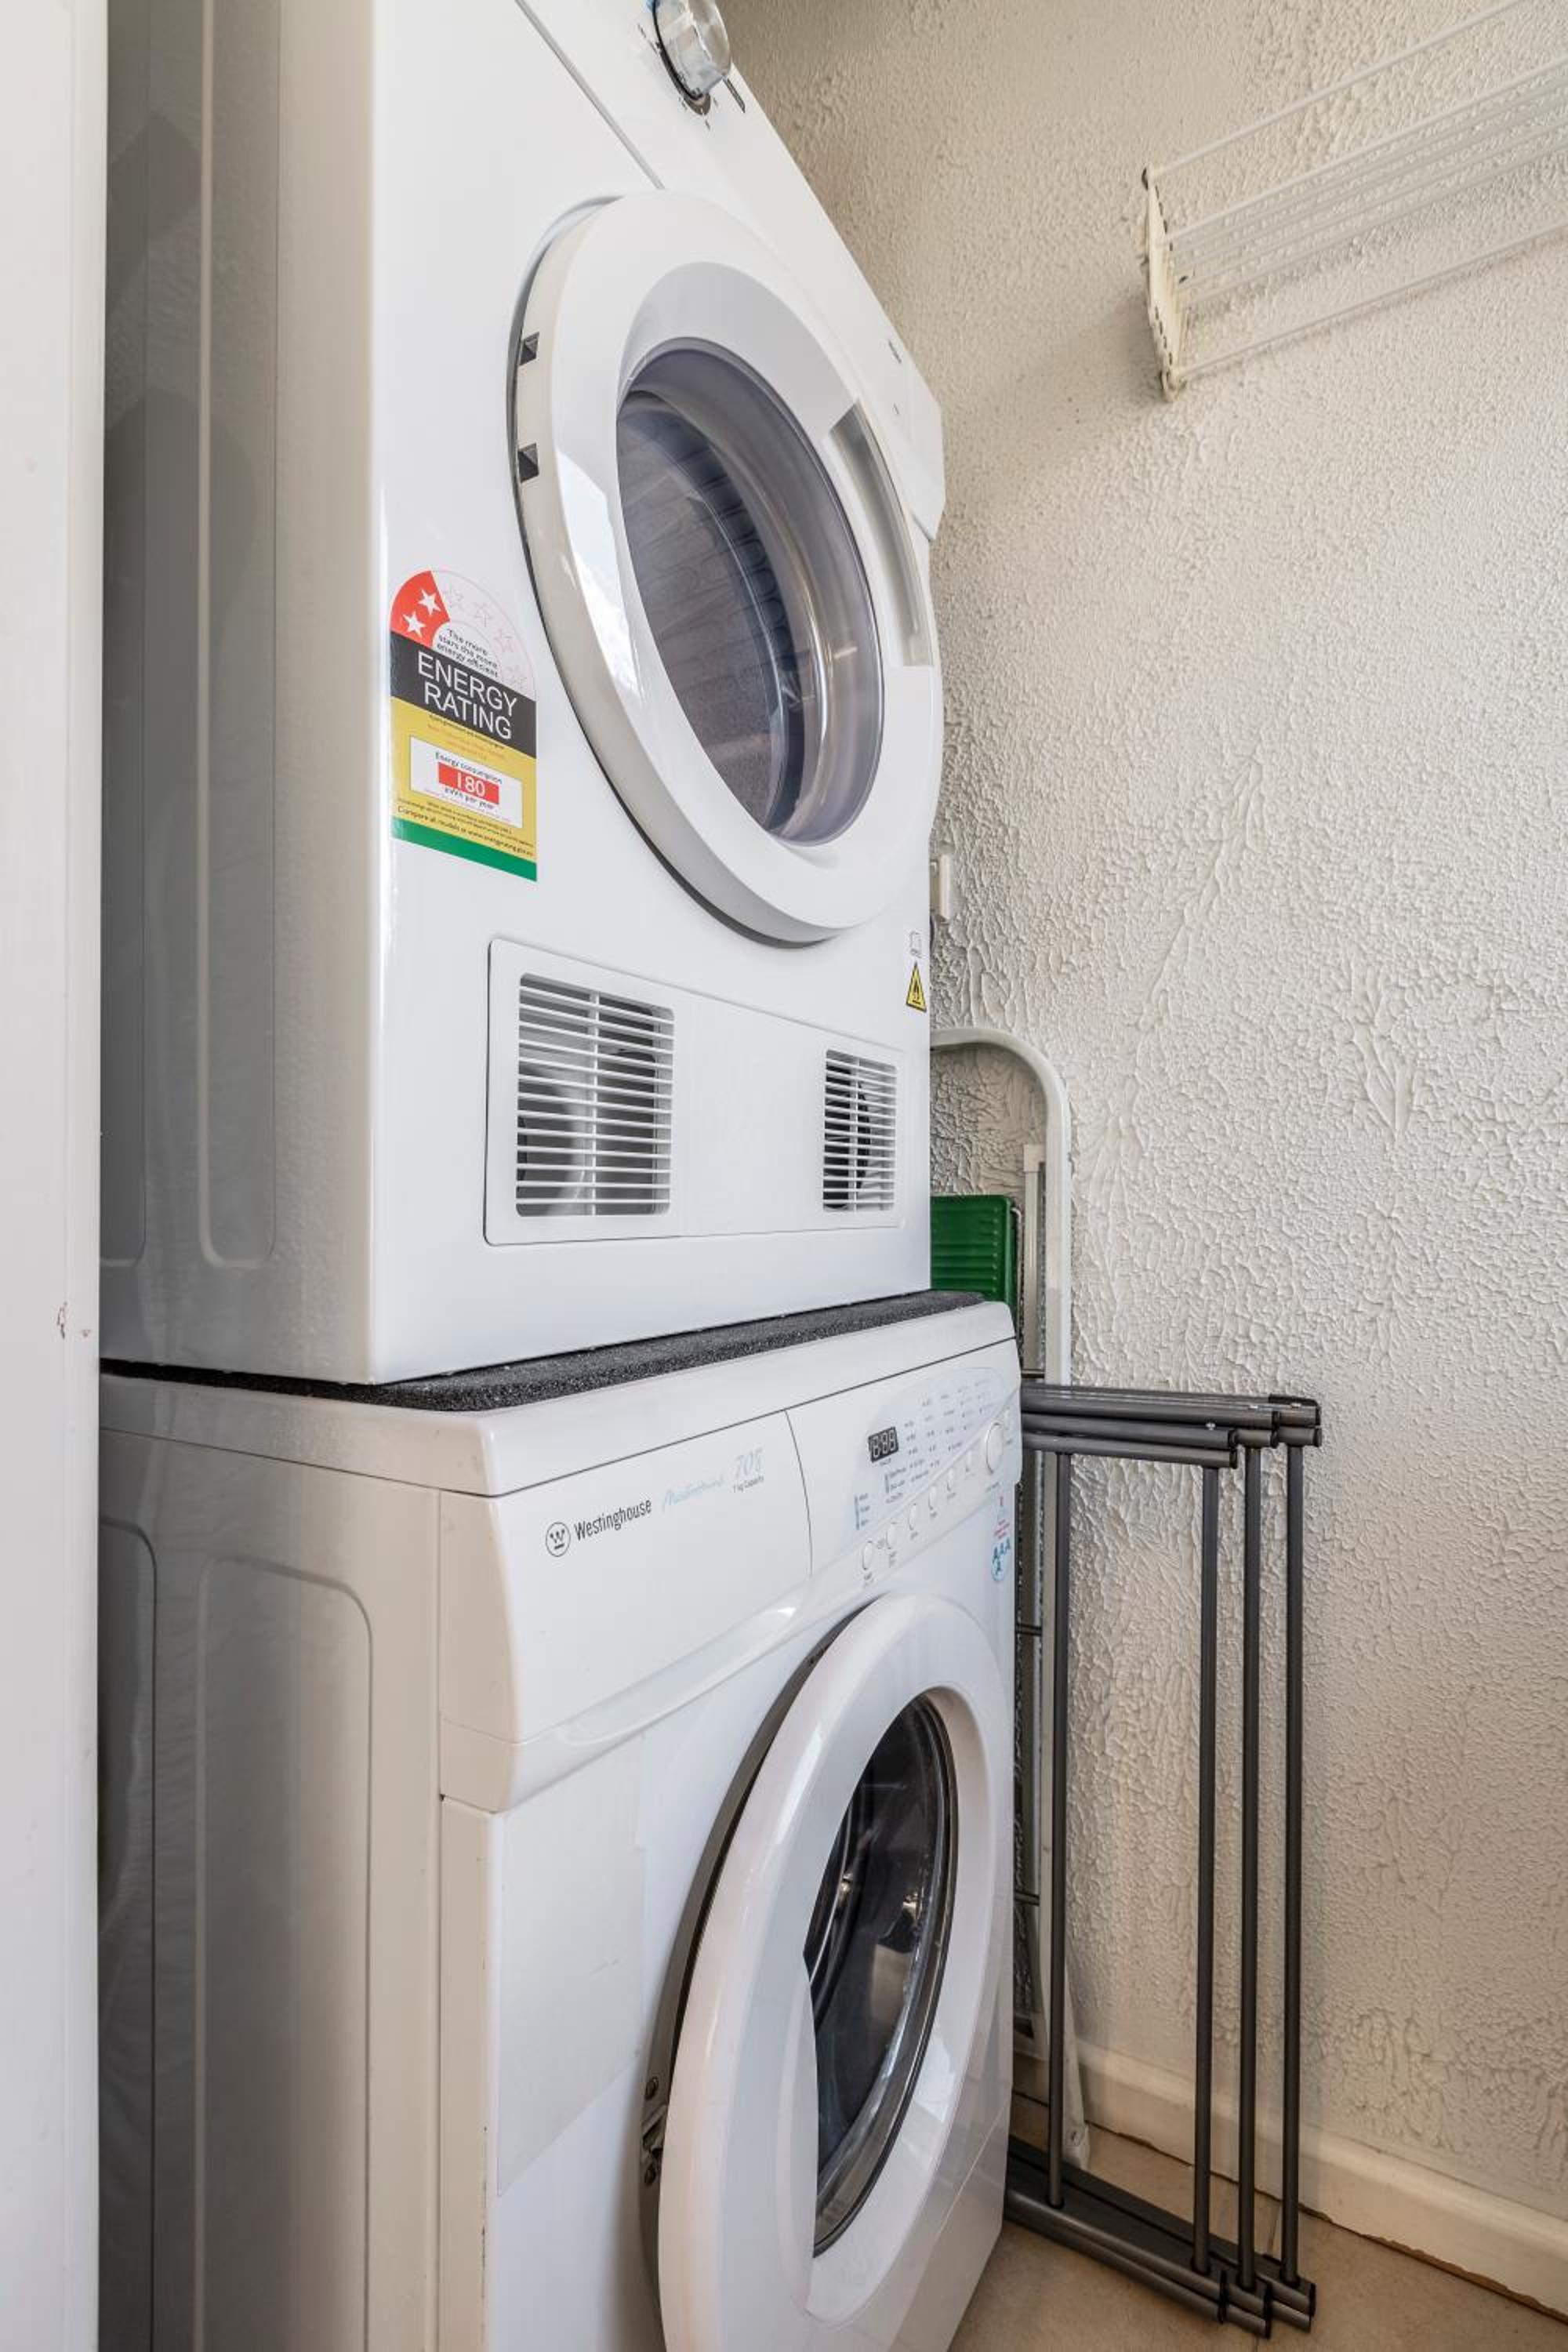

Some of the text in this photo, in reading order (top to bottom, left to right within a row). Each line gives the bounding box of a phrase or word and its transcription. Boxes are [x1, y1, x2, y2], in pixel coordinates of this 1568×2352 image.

[418, 650, 517, 717] ENERGY
[424, 681, 512, 739] RATING
[457, 771, 486, 798] 180
[574, 1498, 652, 1541] Westinghouse
